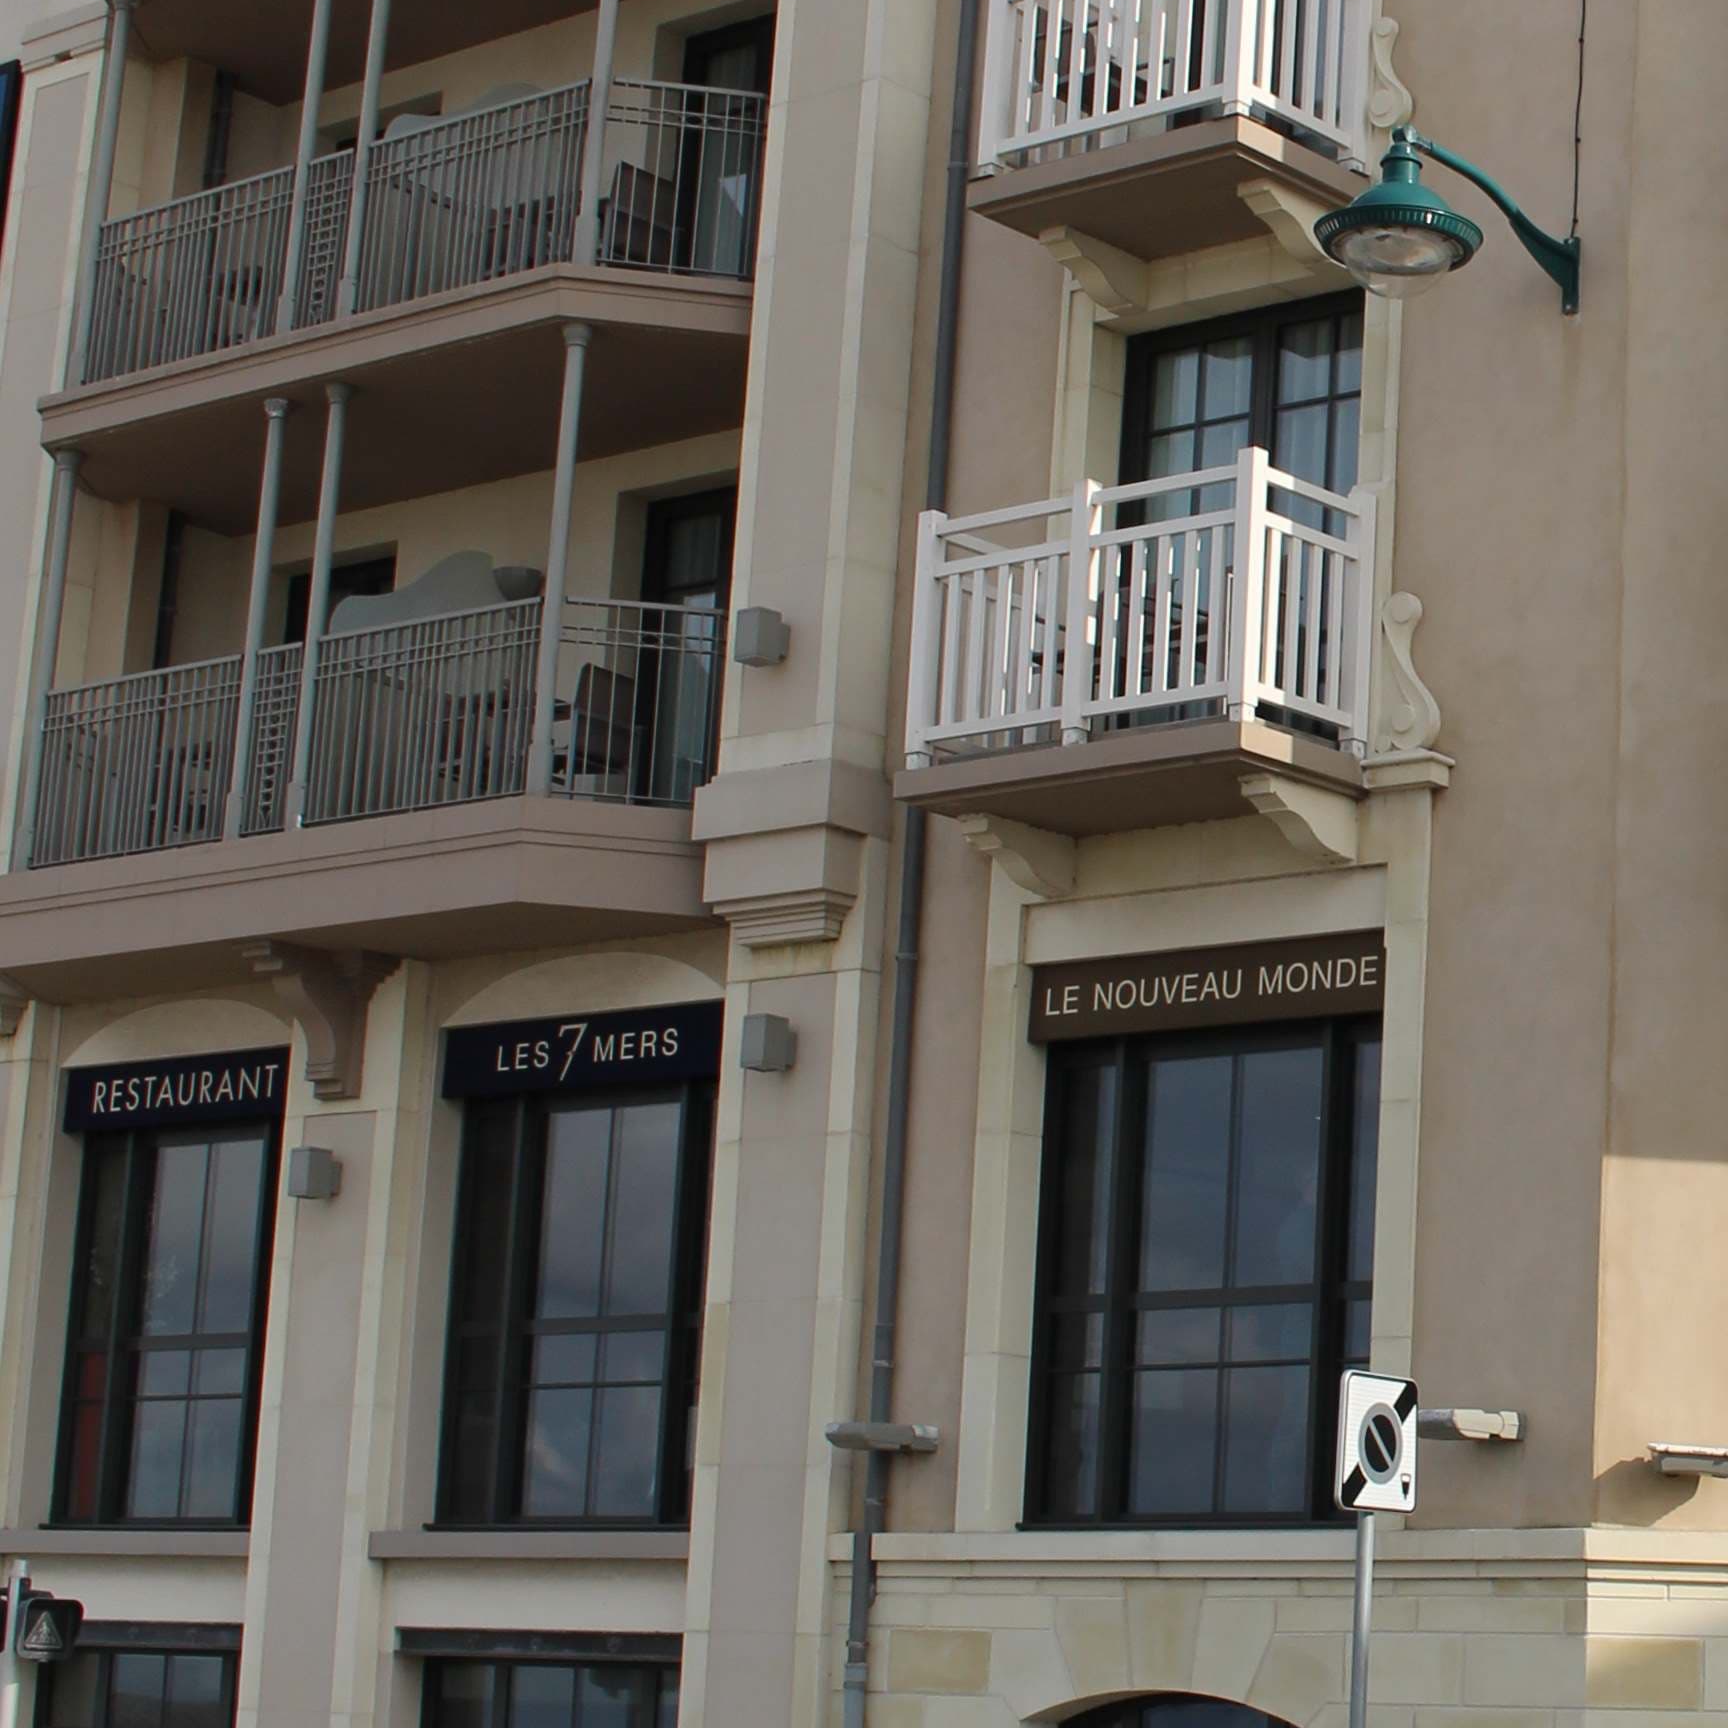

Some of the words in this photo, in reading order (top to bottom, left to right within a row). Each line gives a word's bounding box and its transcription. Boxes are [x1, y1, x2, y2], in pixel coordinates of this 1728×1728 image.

[1045, 985, 1080, 1016] LE
[1093, 968, 1243, 1011] NOUVEAU
[1257, 955, 1378, 995] MONDE
[497, 1041, 549, 1071] LES
[557, 1023, 588, 1082] 7
[593, 1027, 679, 1062] MERS
[93, 1065, 278, 1113] RESTAURANT
